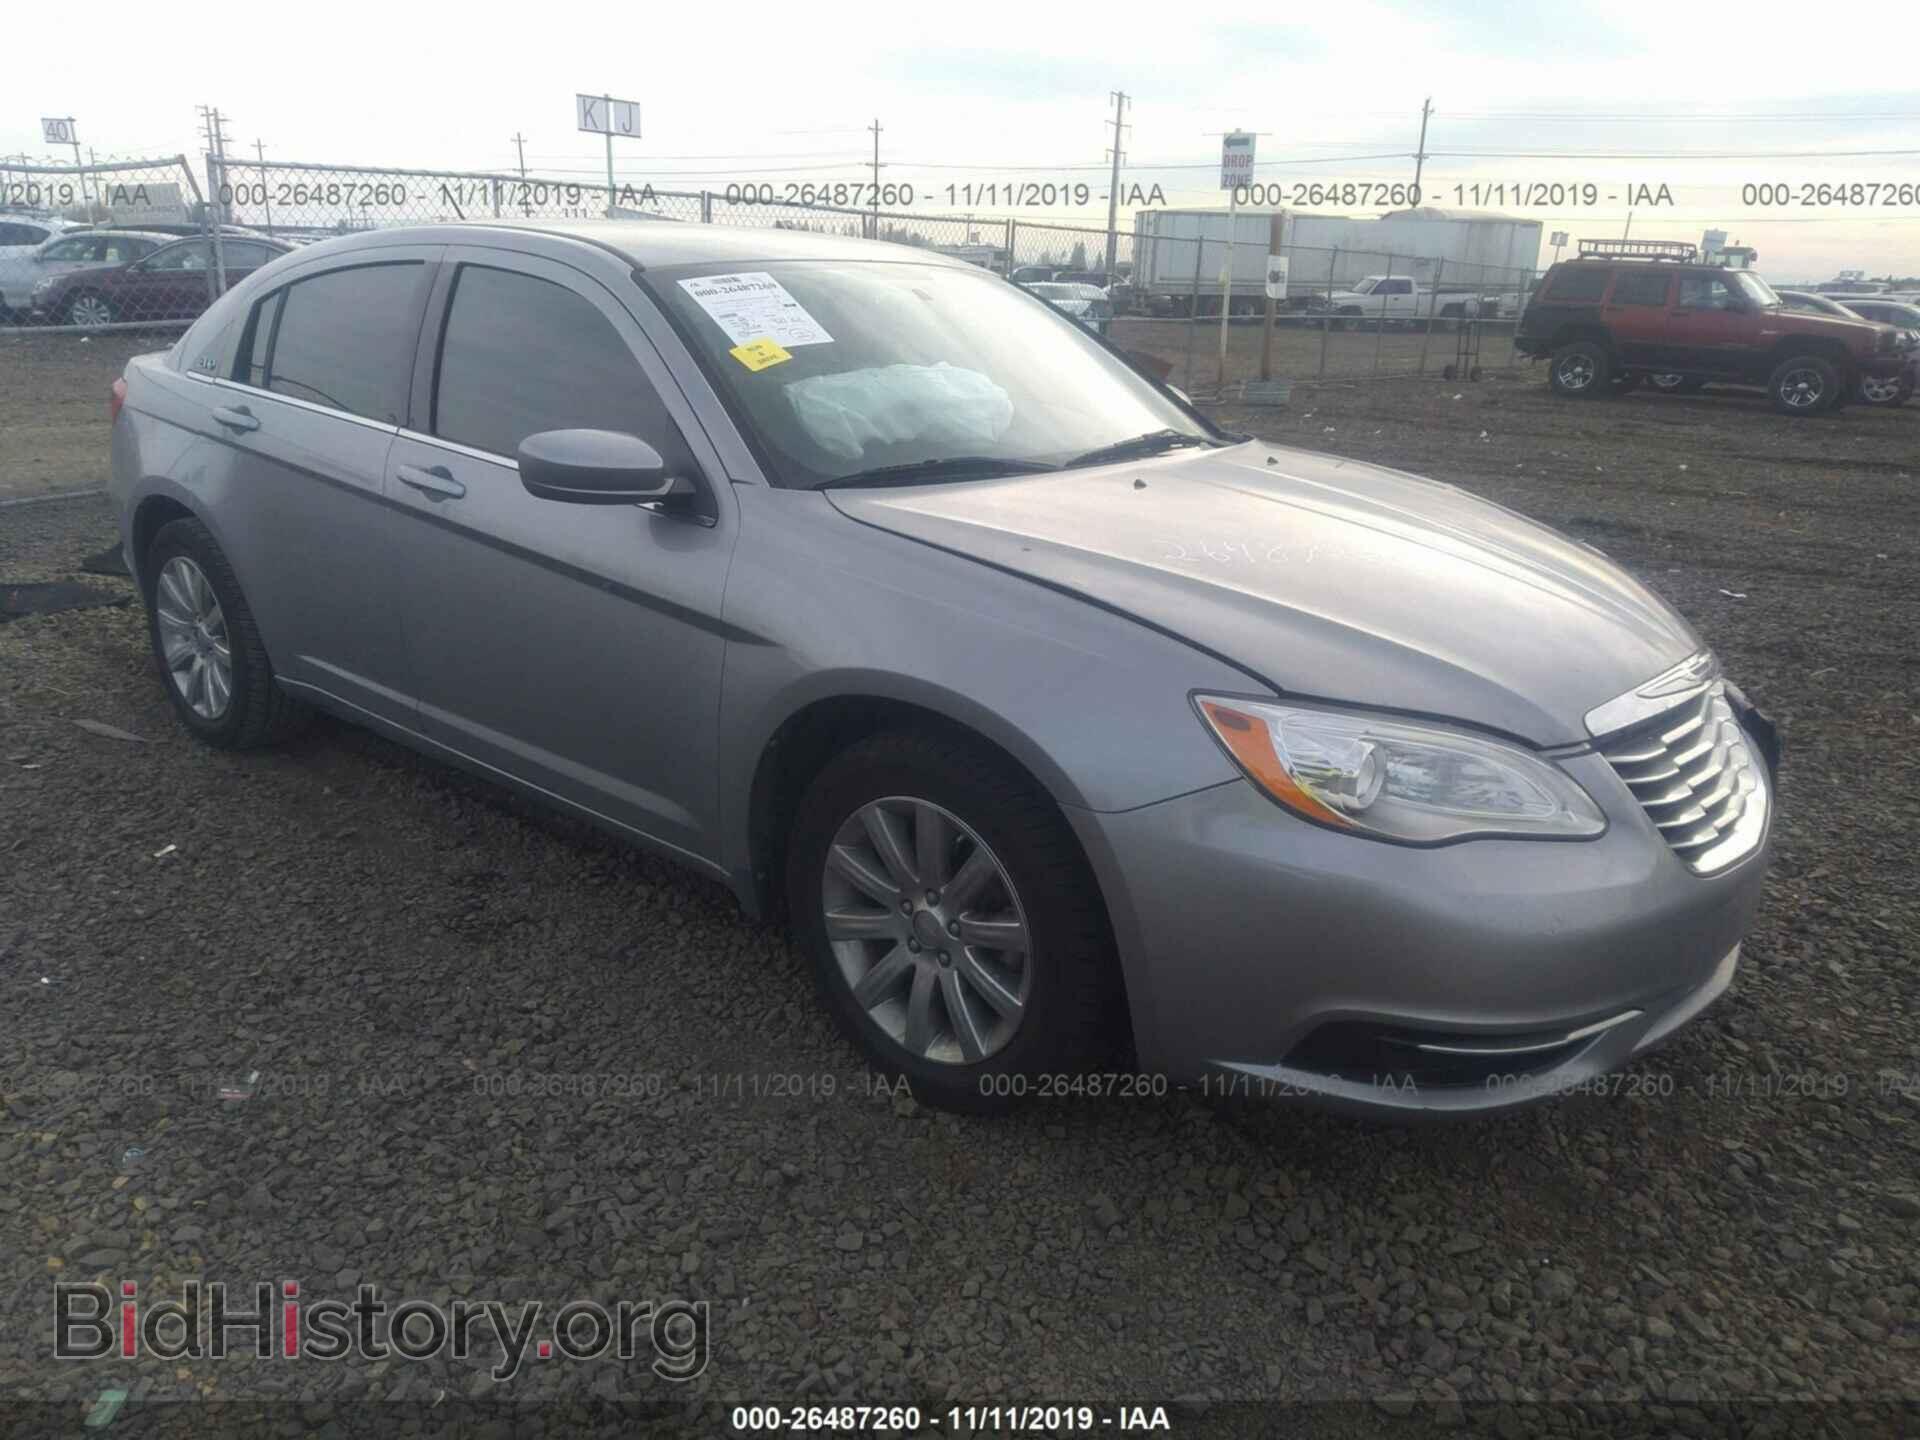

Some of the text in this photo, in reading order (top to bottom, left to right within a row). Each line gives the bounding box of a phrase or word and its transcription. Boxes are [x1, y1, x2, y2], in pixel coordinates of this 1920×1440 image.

[582, 97, 599, 129] K
[622, 103, 633, 133] J
[46, 121, 69, 141] 40
[1223, 153, 1254, 168] DROP
